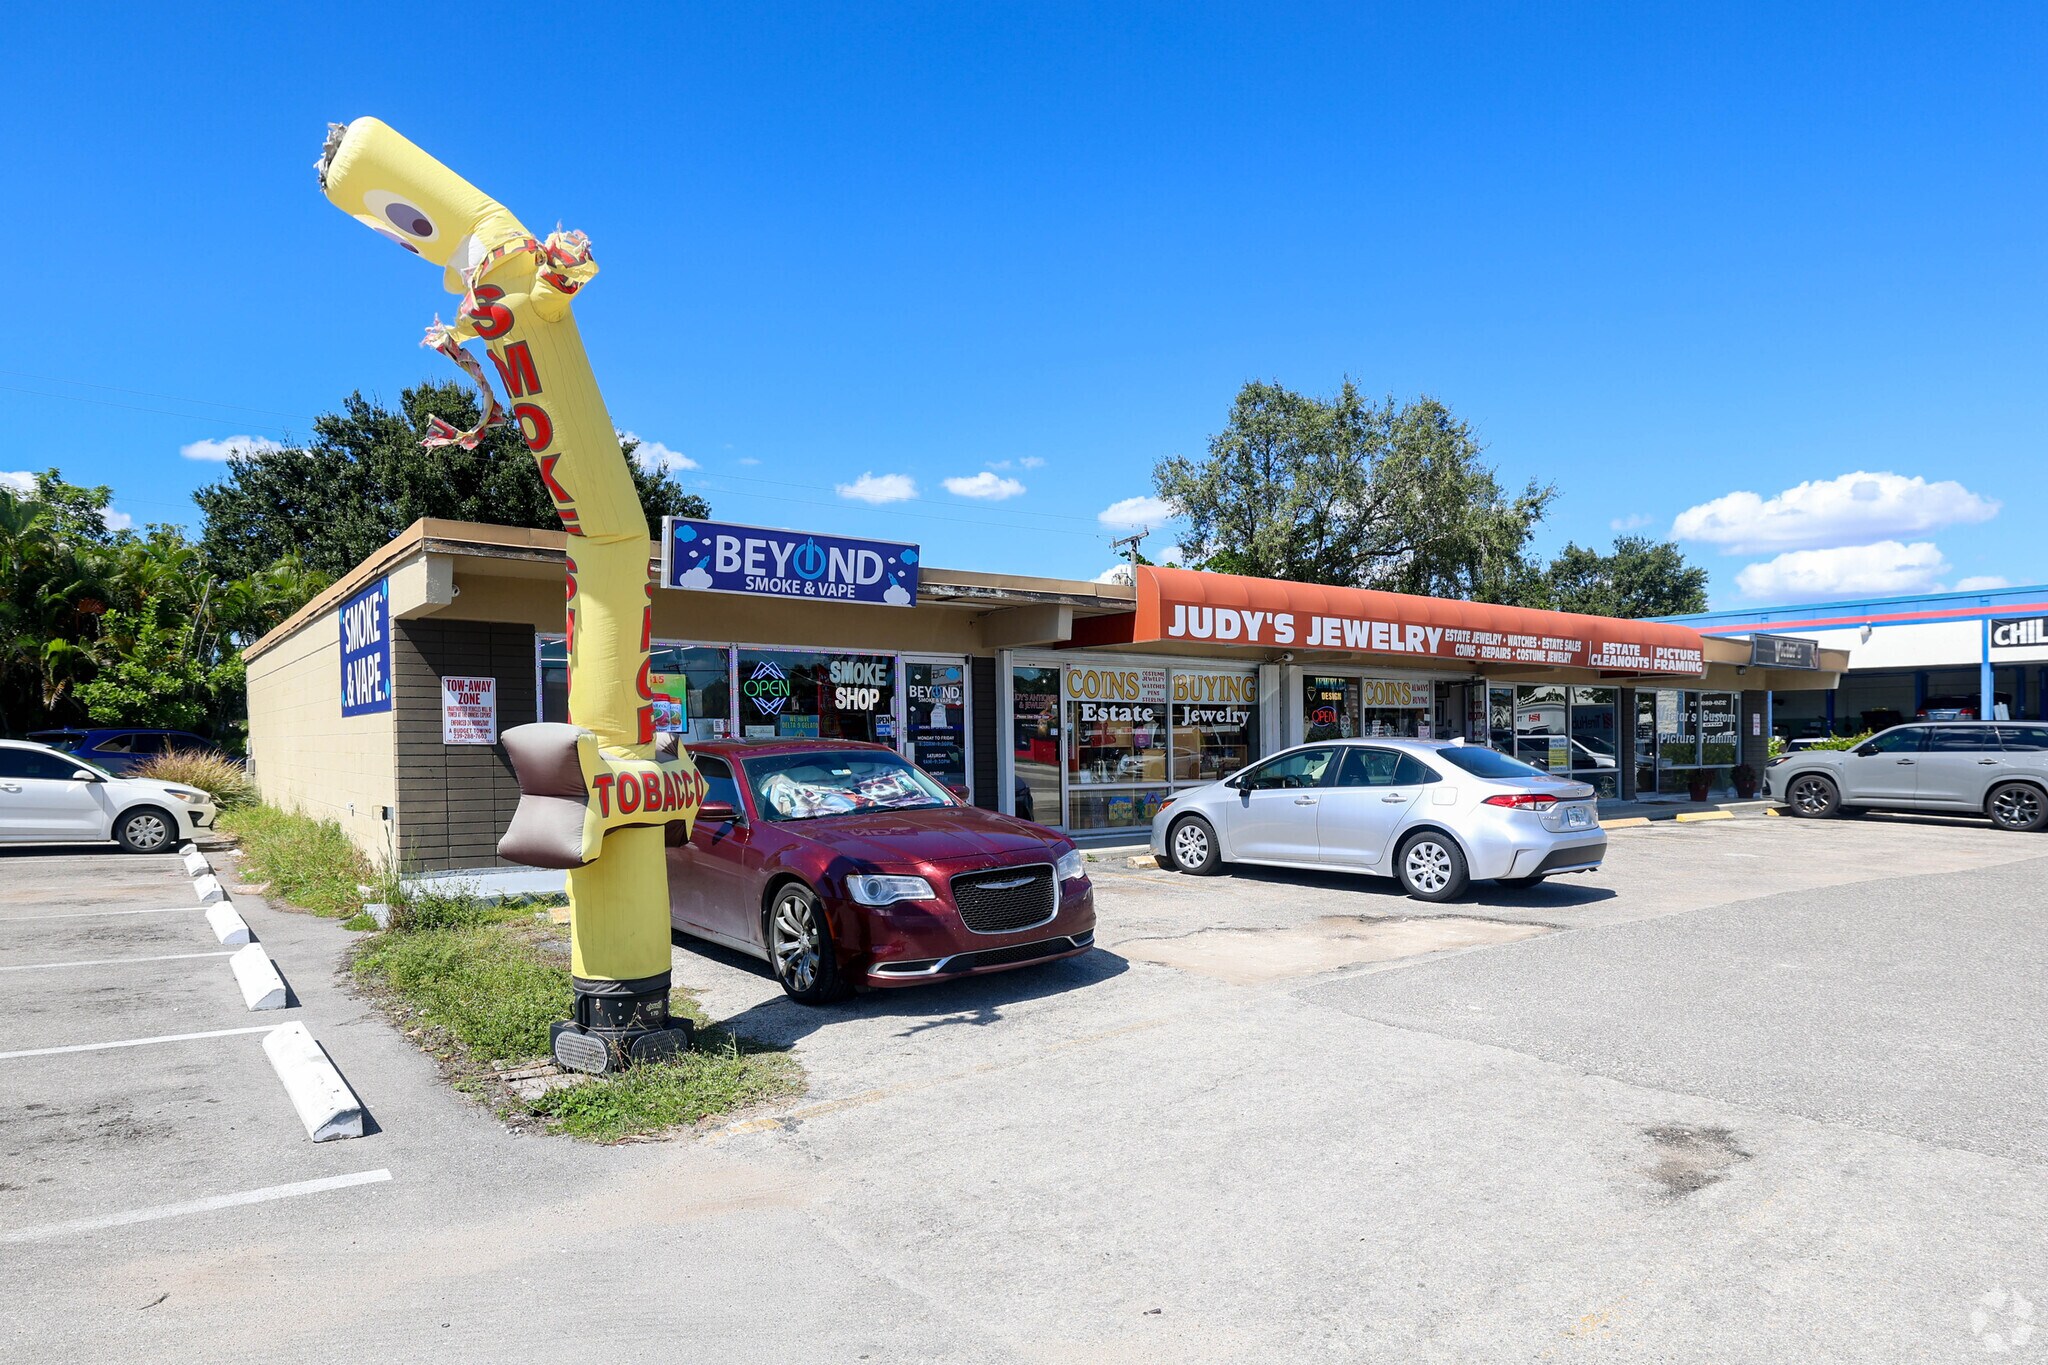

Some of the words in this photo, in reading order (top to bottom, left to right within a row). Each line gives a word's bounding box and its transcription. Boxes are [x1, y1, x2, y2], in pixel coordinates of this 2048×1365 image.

[715, 535, 884, 586] BEYOND
[745, 576, 801, 594] SMOKE
[803, 581, 815, 595] &
[817, 582, 856, 598] VAPE
[345, 591, 381, 655] SMOKE
[1168, 604, 1295, 644] JUDY'S
[1306, 616, 1443, 653] JEWELRY
[1445, 628, 1470, 643] ESTATE
[1472, 631, 1502, 645] JEWELRY
[1507, 634, 1537, 648] WATCHES
[1541, 637, 1563, 650] ESTATE
[1564, 640, 1581, 652] SALES
[1602, 642, 1640, 656] ESTATE
[1455, 643, 1475, 657] COINS
[1481, 646, 1511, 660] REPAIRS
[1516, 649, 1545, 662] COSTUME
[1547, 652, 1572, 664] JEWELRY
[1591, 654, 1649, 669] CLEANOUTS
[1656, 647, 1700, 660] PICTURE
[829, 661, 887, 686] SMOKE
[1654, 659, 1702, 673] FRAMING
[346, 662, 355, 708] &
[354, 652, 382, 705] VAPE
[446, 679, 491, 692] TOW-AWAY
[743, 680, 790, 697] OPEN
[1067, 669, 1139, 701] COINS
[1173, 674, 1256, 702] BUYING
[458, 692, 481, 705] ZONE
[834, 687, 879, 711] SHOP
[909, 685, 960, 699] BEYOND
[1321, 692, 1342, 701] DESIGN
[1364, 681, 1412, 705] COINS
[876, 716, 890, 724] OPEN
[1081, 703, 1154, 722] Estate
[1181, 706, 1250, 727] Jewelry
[1311, 710, 1336, 723] OPEN
[1703, 710, 1736, 723] Custom
[1660, 733, 1696, 744] Picture
[1701, 732, 1738, 746] Framing
[592, 770, 704, 818] TOBACCO
